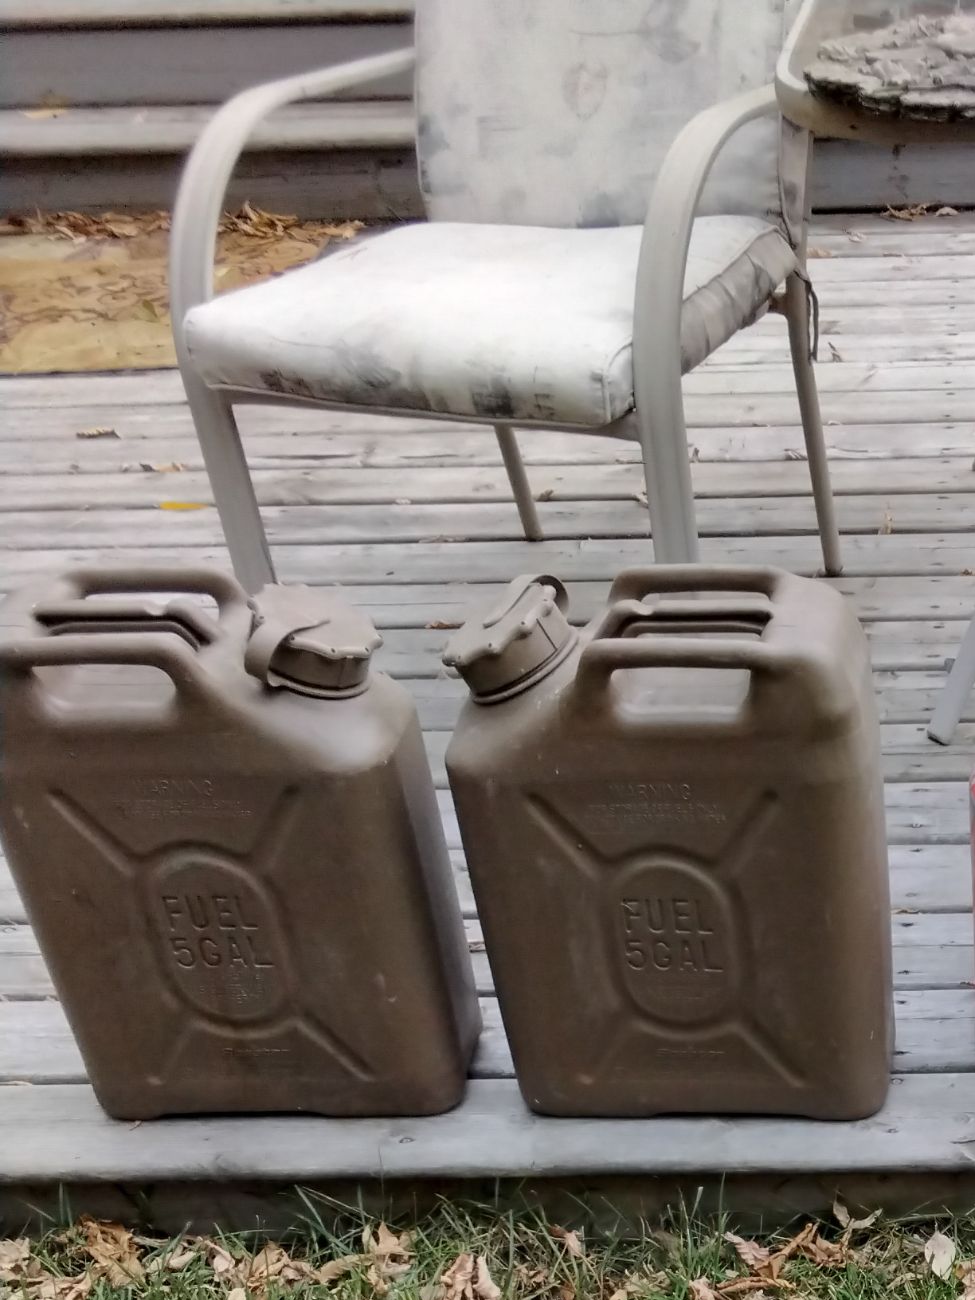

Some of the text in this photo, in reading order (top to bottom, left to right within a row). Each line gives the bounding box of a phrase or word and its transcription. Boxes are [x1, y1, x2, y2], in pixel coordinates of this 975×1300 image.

[609, 783, 692, 801] WARNING
[162, 896, 259, 930] FUEL
[622, 898, 714, 935] FUEL
